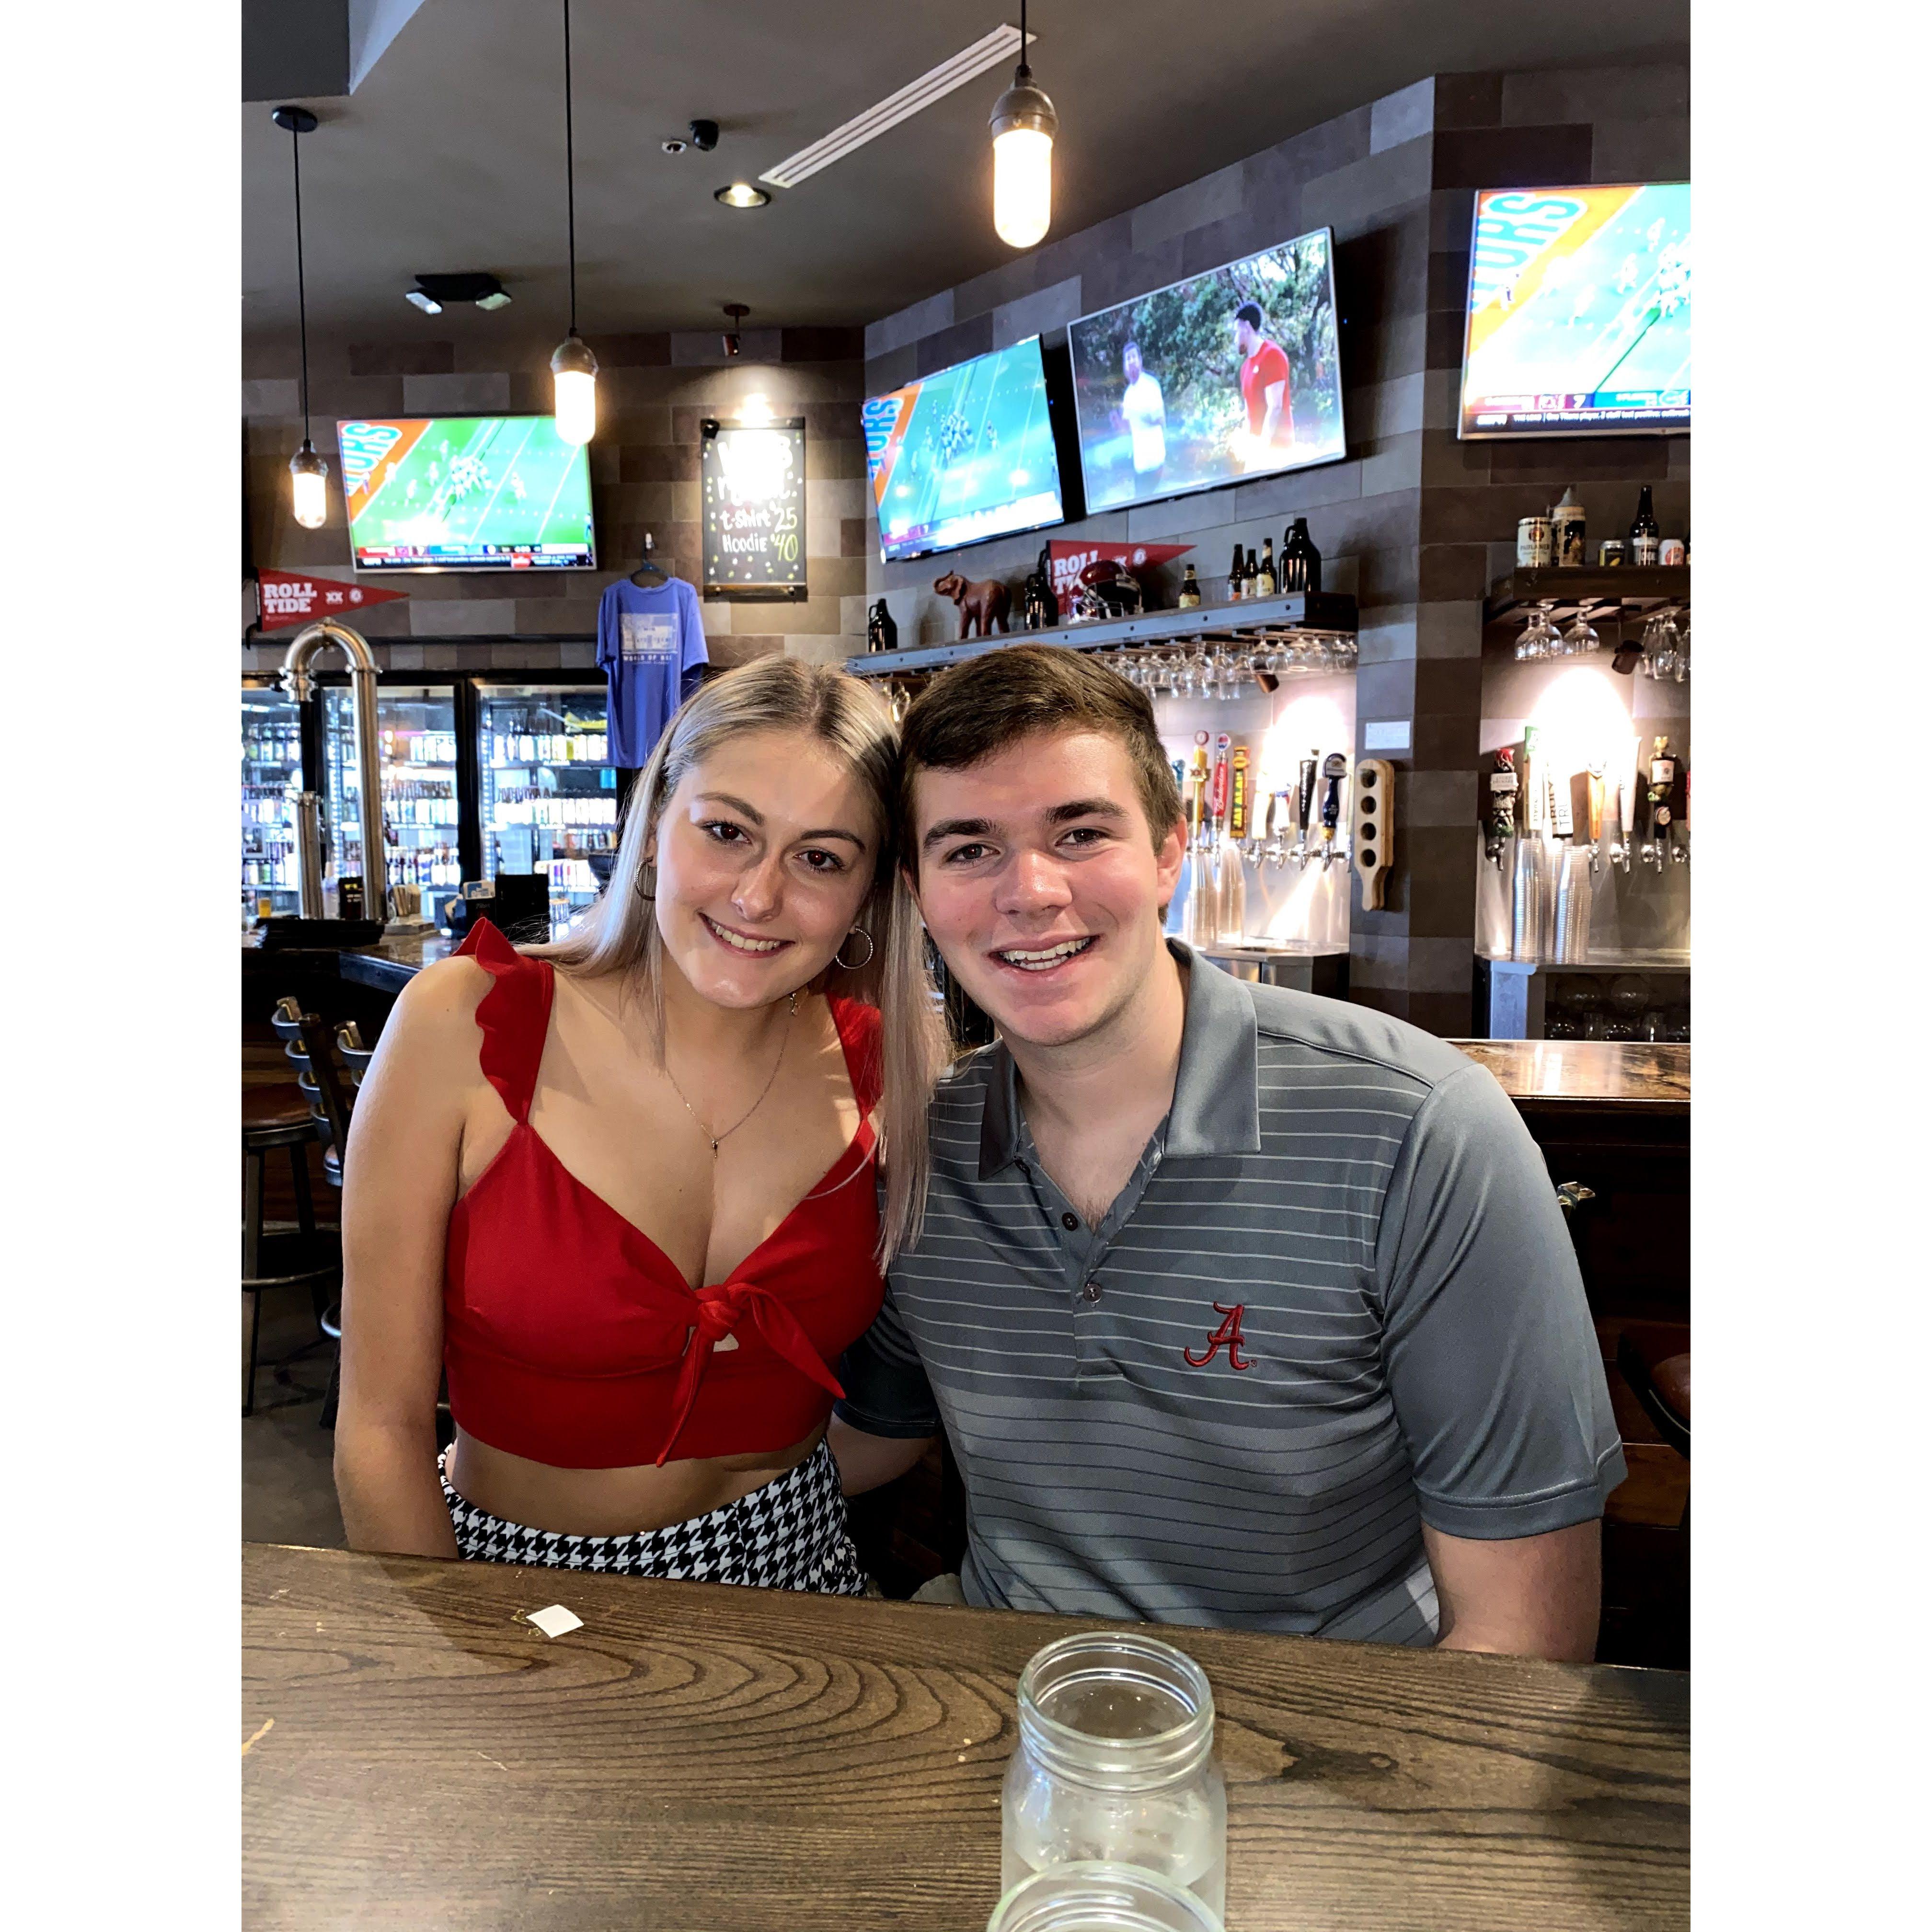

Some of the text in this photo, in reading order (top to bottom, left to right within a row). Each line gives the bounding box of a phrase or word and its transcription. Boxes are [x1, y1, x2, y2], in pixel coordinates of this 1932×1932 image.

[264, 583, 318, 598] ROLL
[264, 598, 311, 614] TIDE
[1184, 1301, 1245, 1370] A
